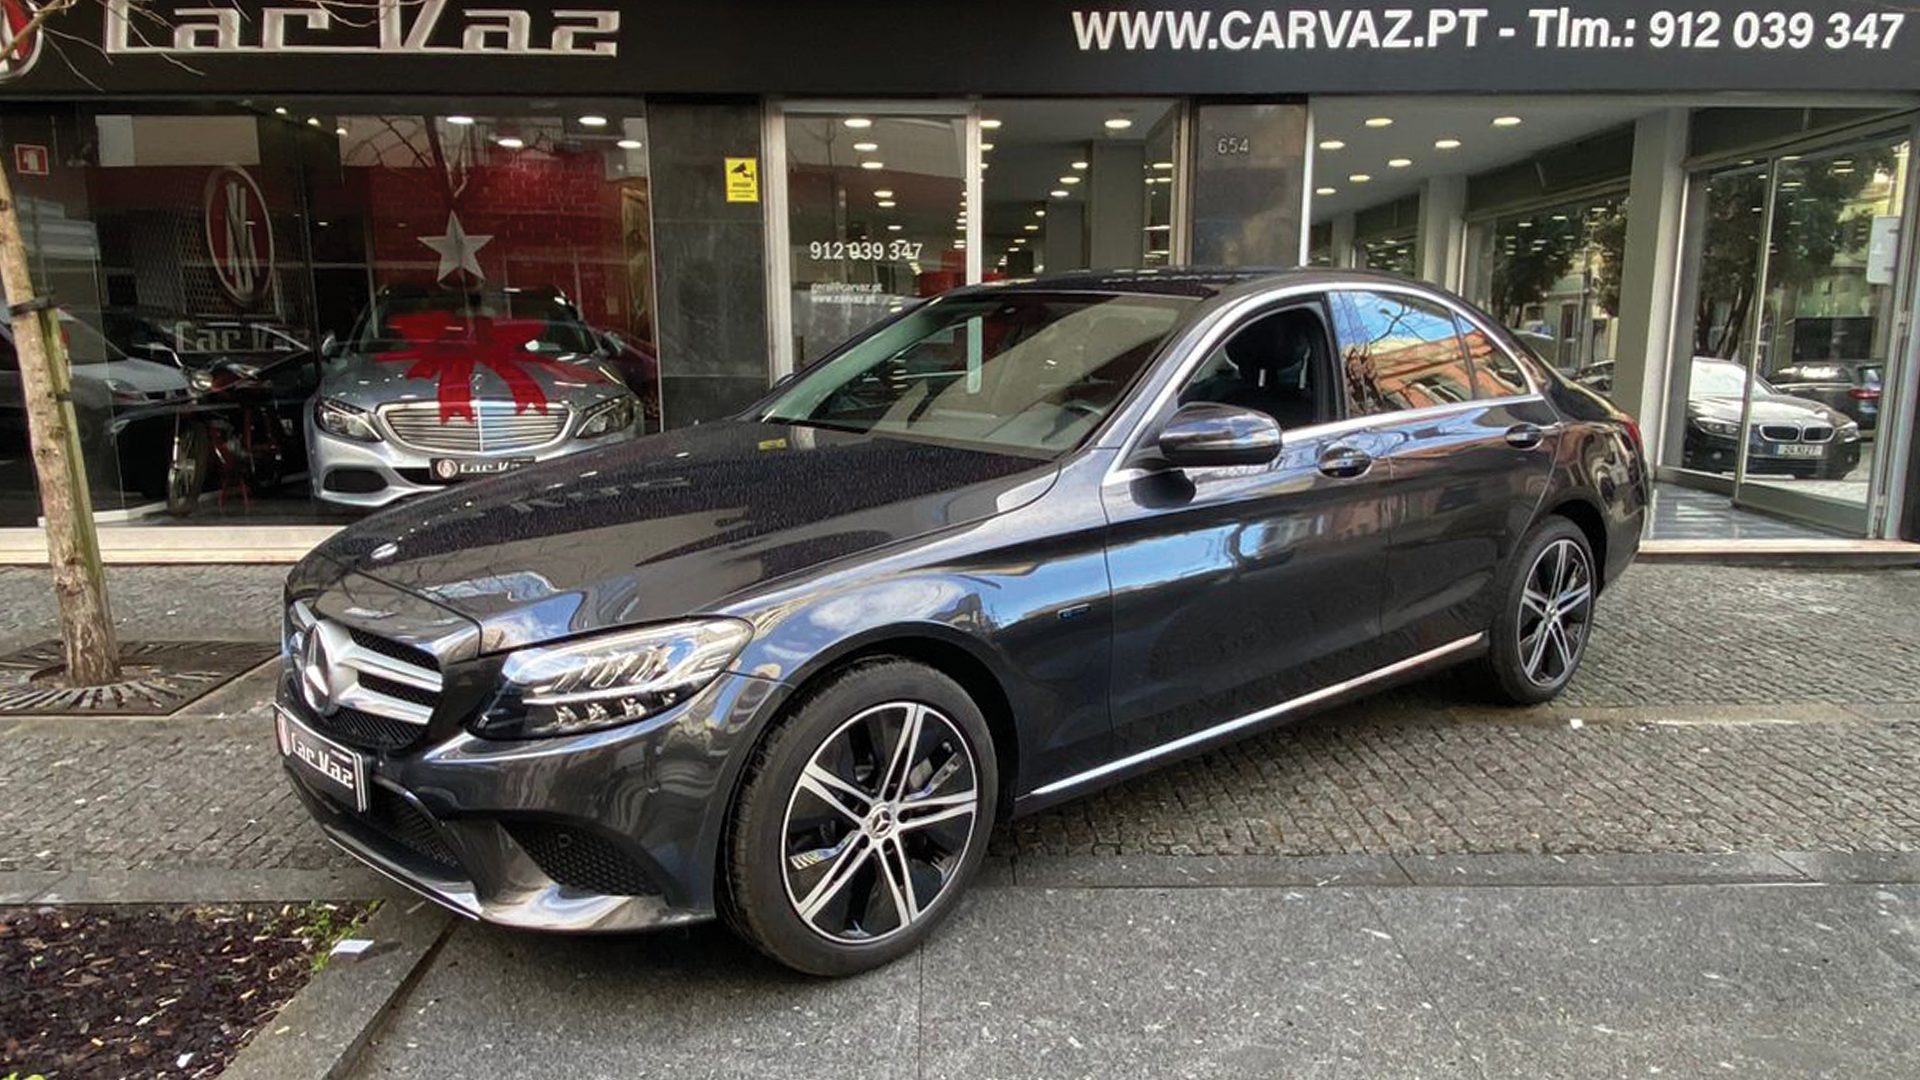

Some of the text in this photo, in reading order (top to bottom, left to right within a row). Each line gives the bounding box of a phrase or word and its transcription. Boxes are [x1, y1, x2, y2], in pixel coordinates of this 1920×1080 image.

[1072, 9, 1488, 50] WWW.CARVAZ.PT
[1528, 7, 1636, 48] Tlm.:
[1648, 10, 1720, 49] 912
[1733, 11, 1815, 50] 039
[1825, 12, 1905, 50] 347
[1217, 137, 1249, 154] 654
[810, 241, 923, 260] 912 039 347
